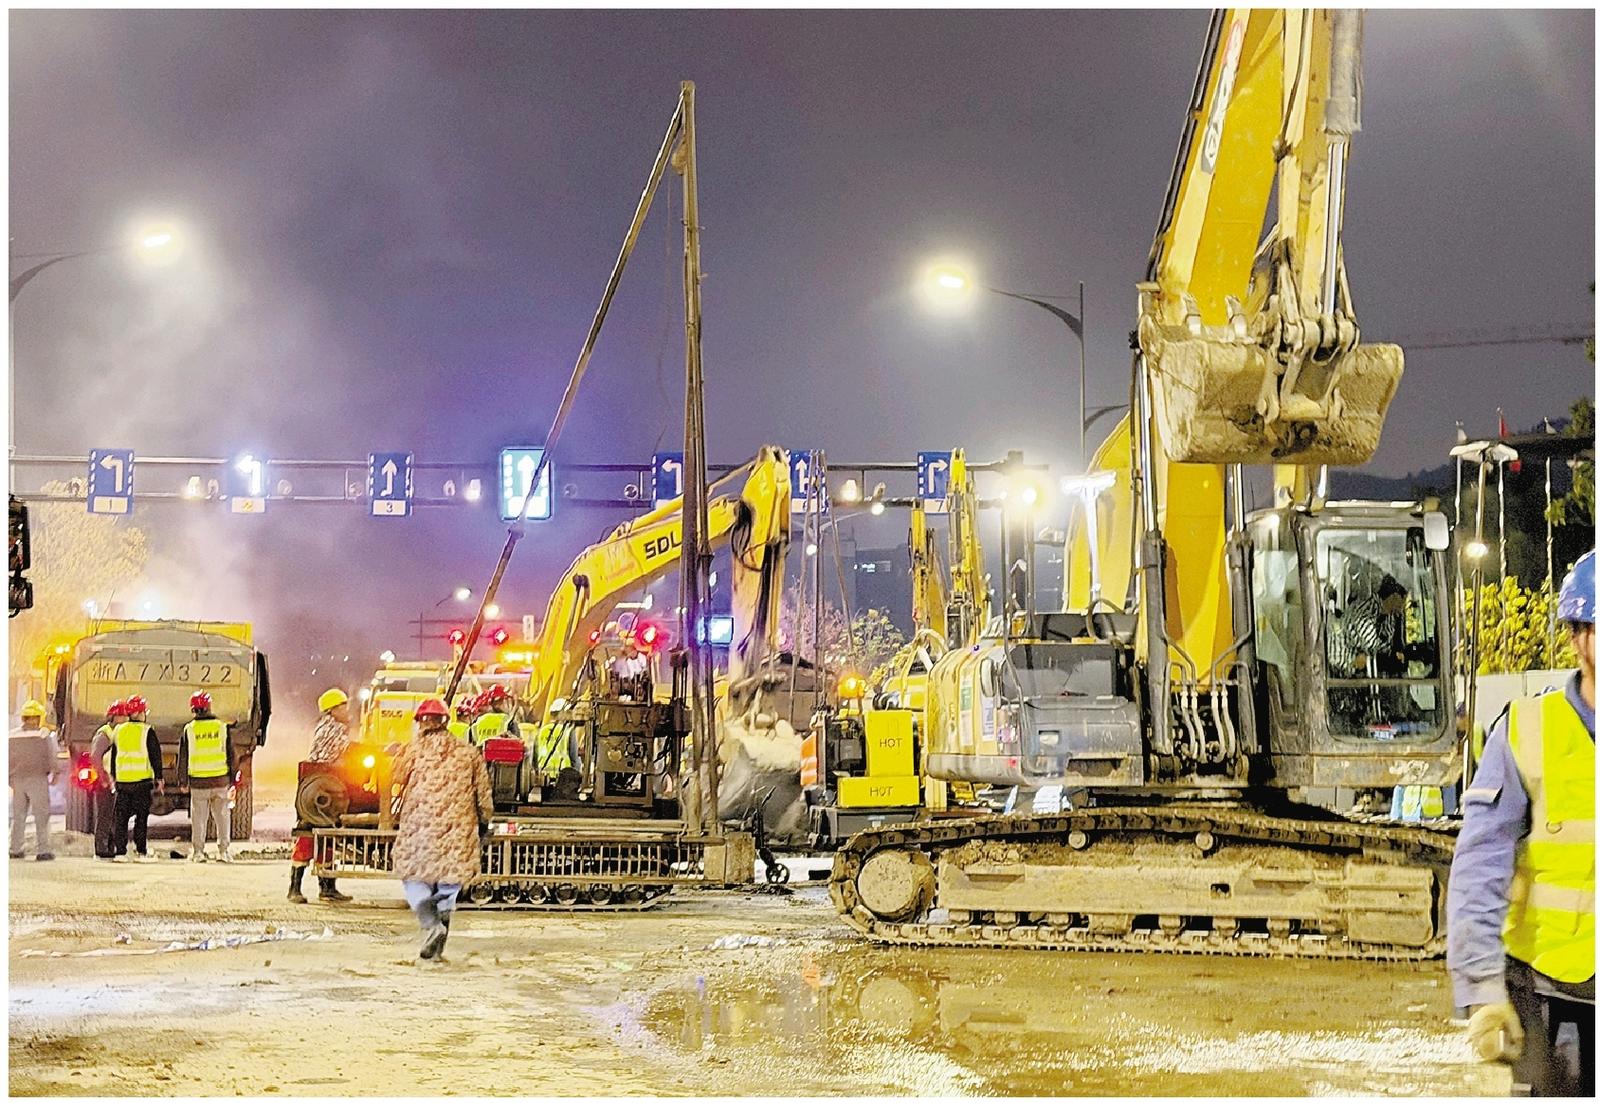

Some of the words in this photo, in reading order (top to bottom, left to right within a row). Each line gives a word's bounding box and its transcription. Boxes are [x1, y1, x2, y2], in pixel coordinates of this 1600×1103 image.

[386, 501, 393, 513] 3
[934, 499, 944, 512] 7
[643, 531, 682, 560] SDL
[879, 737, 903, 748] HOT
[869, 786, 893, 797] HOT
